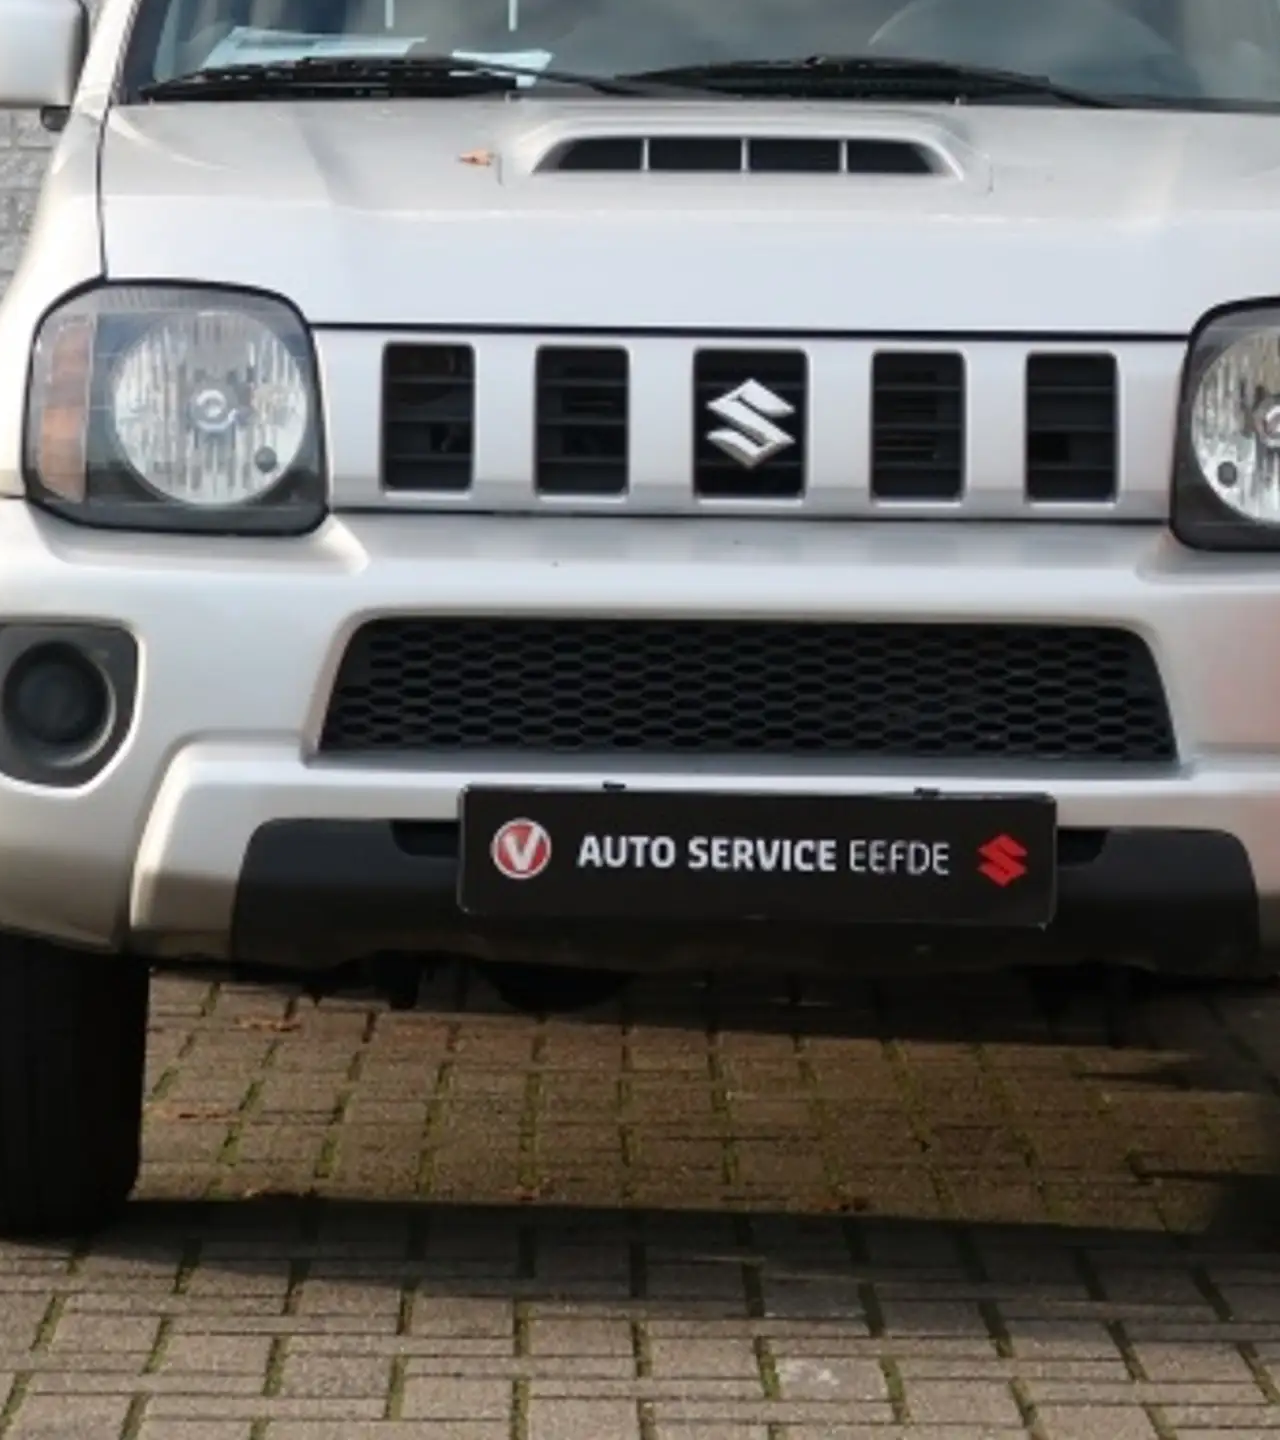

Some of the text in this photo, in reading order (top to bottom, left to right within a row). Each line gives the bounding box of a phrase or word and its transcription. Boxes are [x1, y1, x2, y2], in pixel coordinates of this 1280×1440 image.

[577, 835, 950, 875] AUTO SERVICE EEFDE
